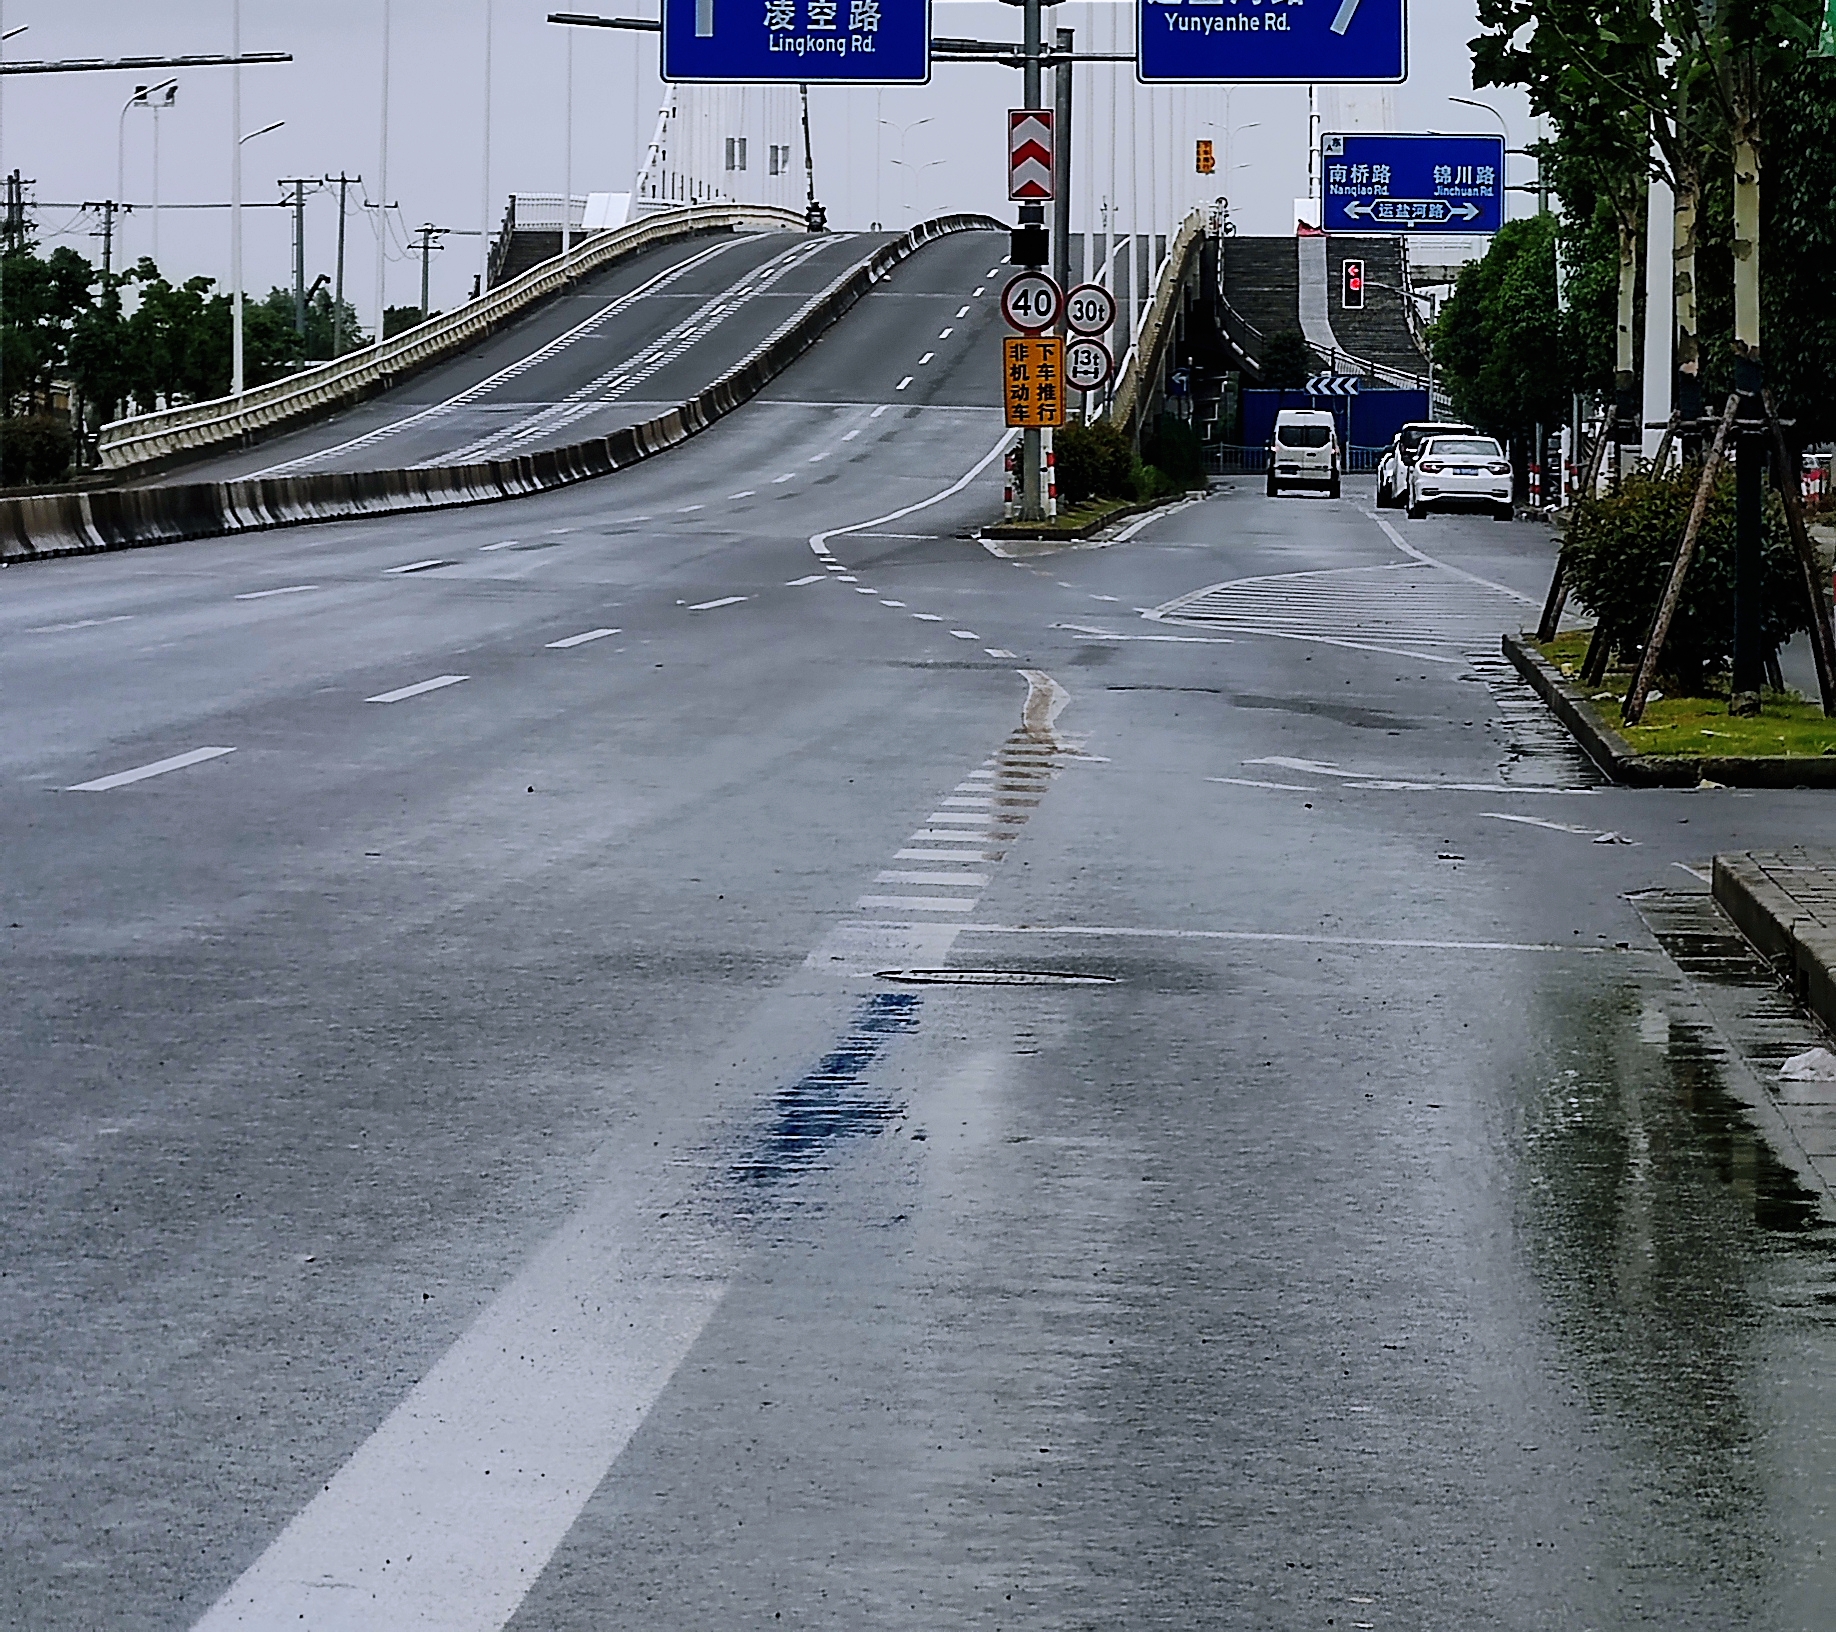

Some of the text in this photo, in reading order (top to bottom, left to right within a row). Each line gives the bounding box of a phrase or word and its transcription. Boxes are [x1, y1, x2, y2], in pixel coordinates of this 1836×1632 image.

[1164, 12, 1291, 36] Yunyanhe Rd.
[769, 34, 876, 57] Lingkong Rd.
[1329, 163, 1391, 184] 南桥路
[1433, 164, 1496, 185] 锦川路
[1329, 184, 1373, 197] Nanqiao
[1433, 186, 1479, 197] Jinchuan
[1378, 203, 1445, 219] 运盐河路
[1011, 288, 1052, 316] 40
[1072, 299, 1106, 322] 30t
[1073, 349, 1100, 366] 13t
[1009, 343, 1030, 422] 非机动车
[1035, 343, 1057, 422] 下车推行
